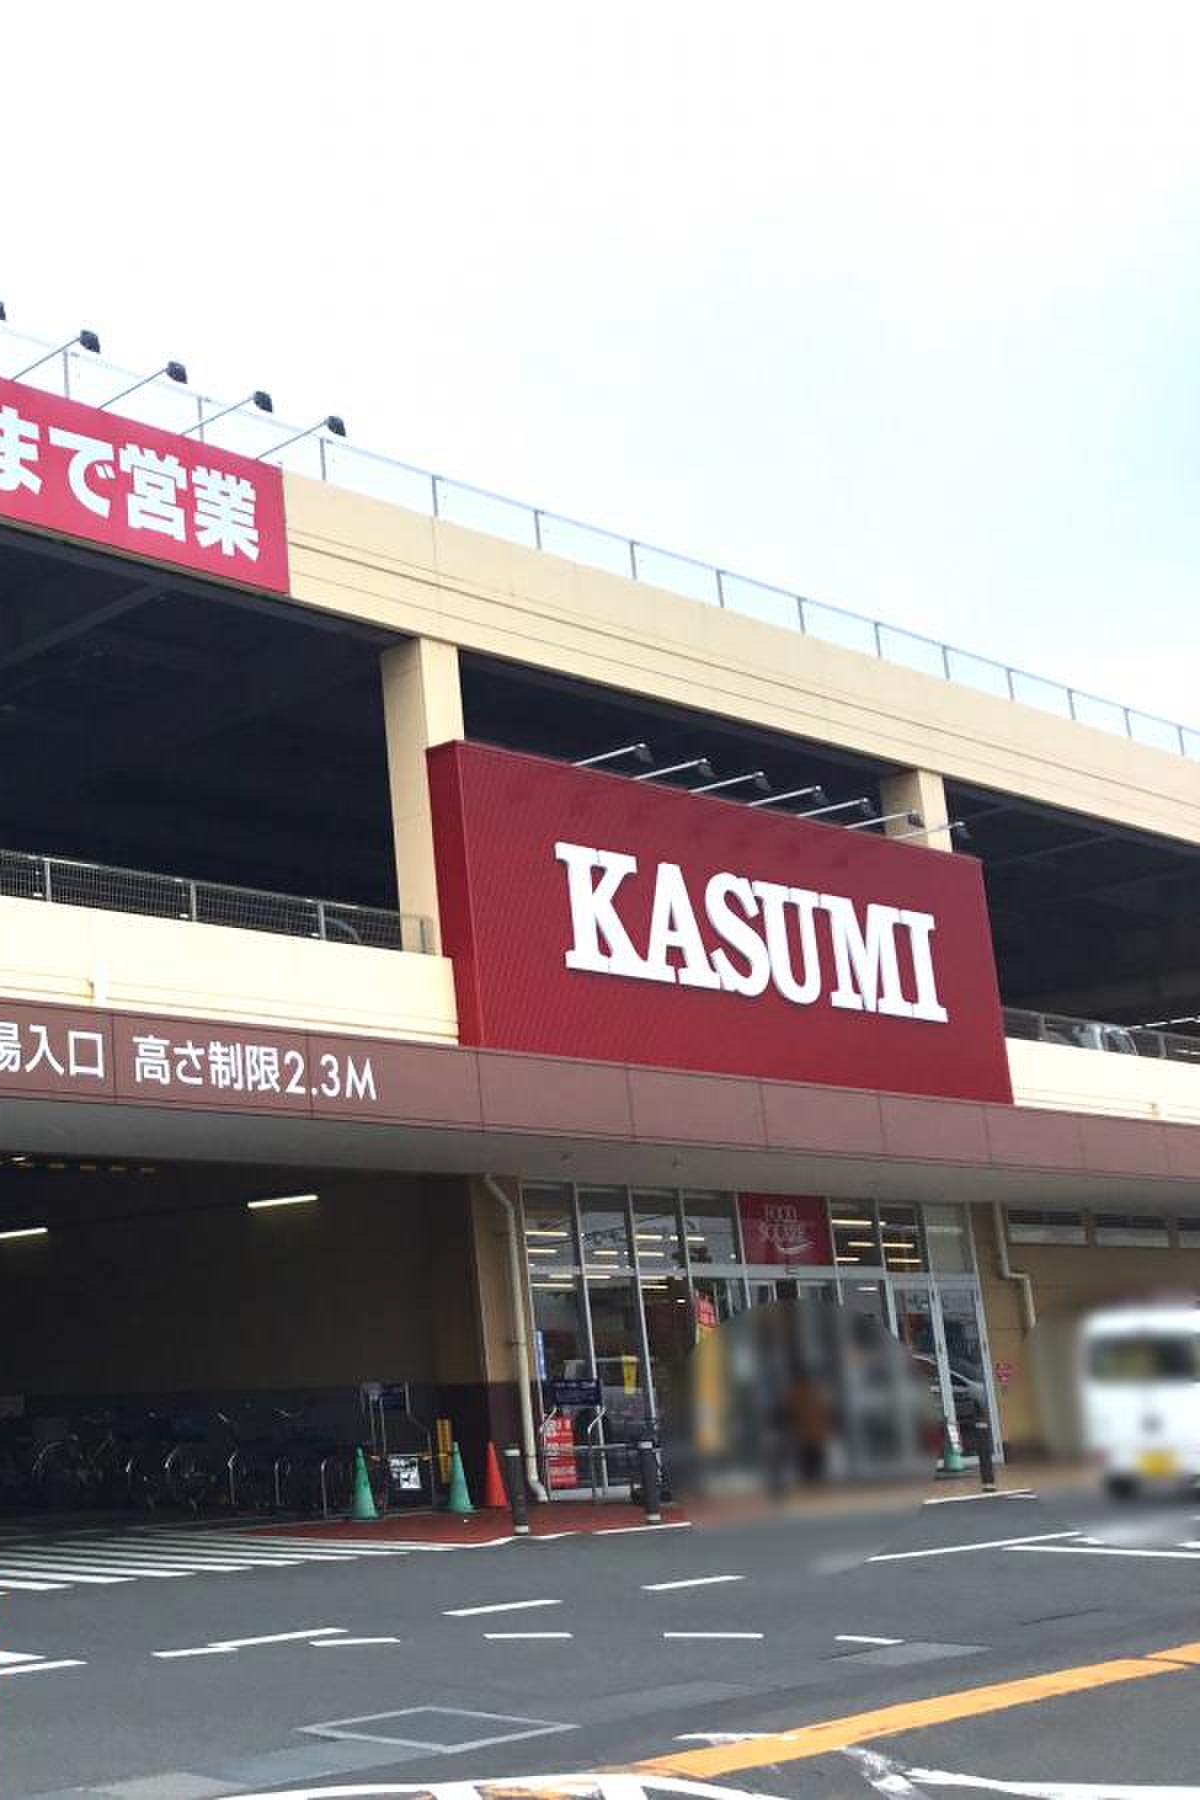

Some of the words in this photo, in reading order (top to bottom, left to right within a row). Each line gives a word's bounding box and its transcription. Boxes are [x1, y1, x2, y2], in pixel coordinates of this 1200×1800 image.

[555, 841, 949, 1023] KASUMI
[133, 1036, 377, 1101] 高さ制限2.3M
